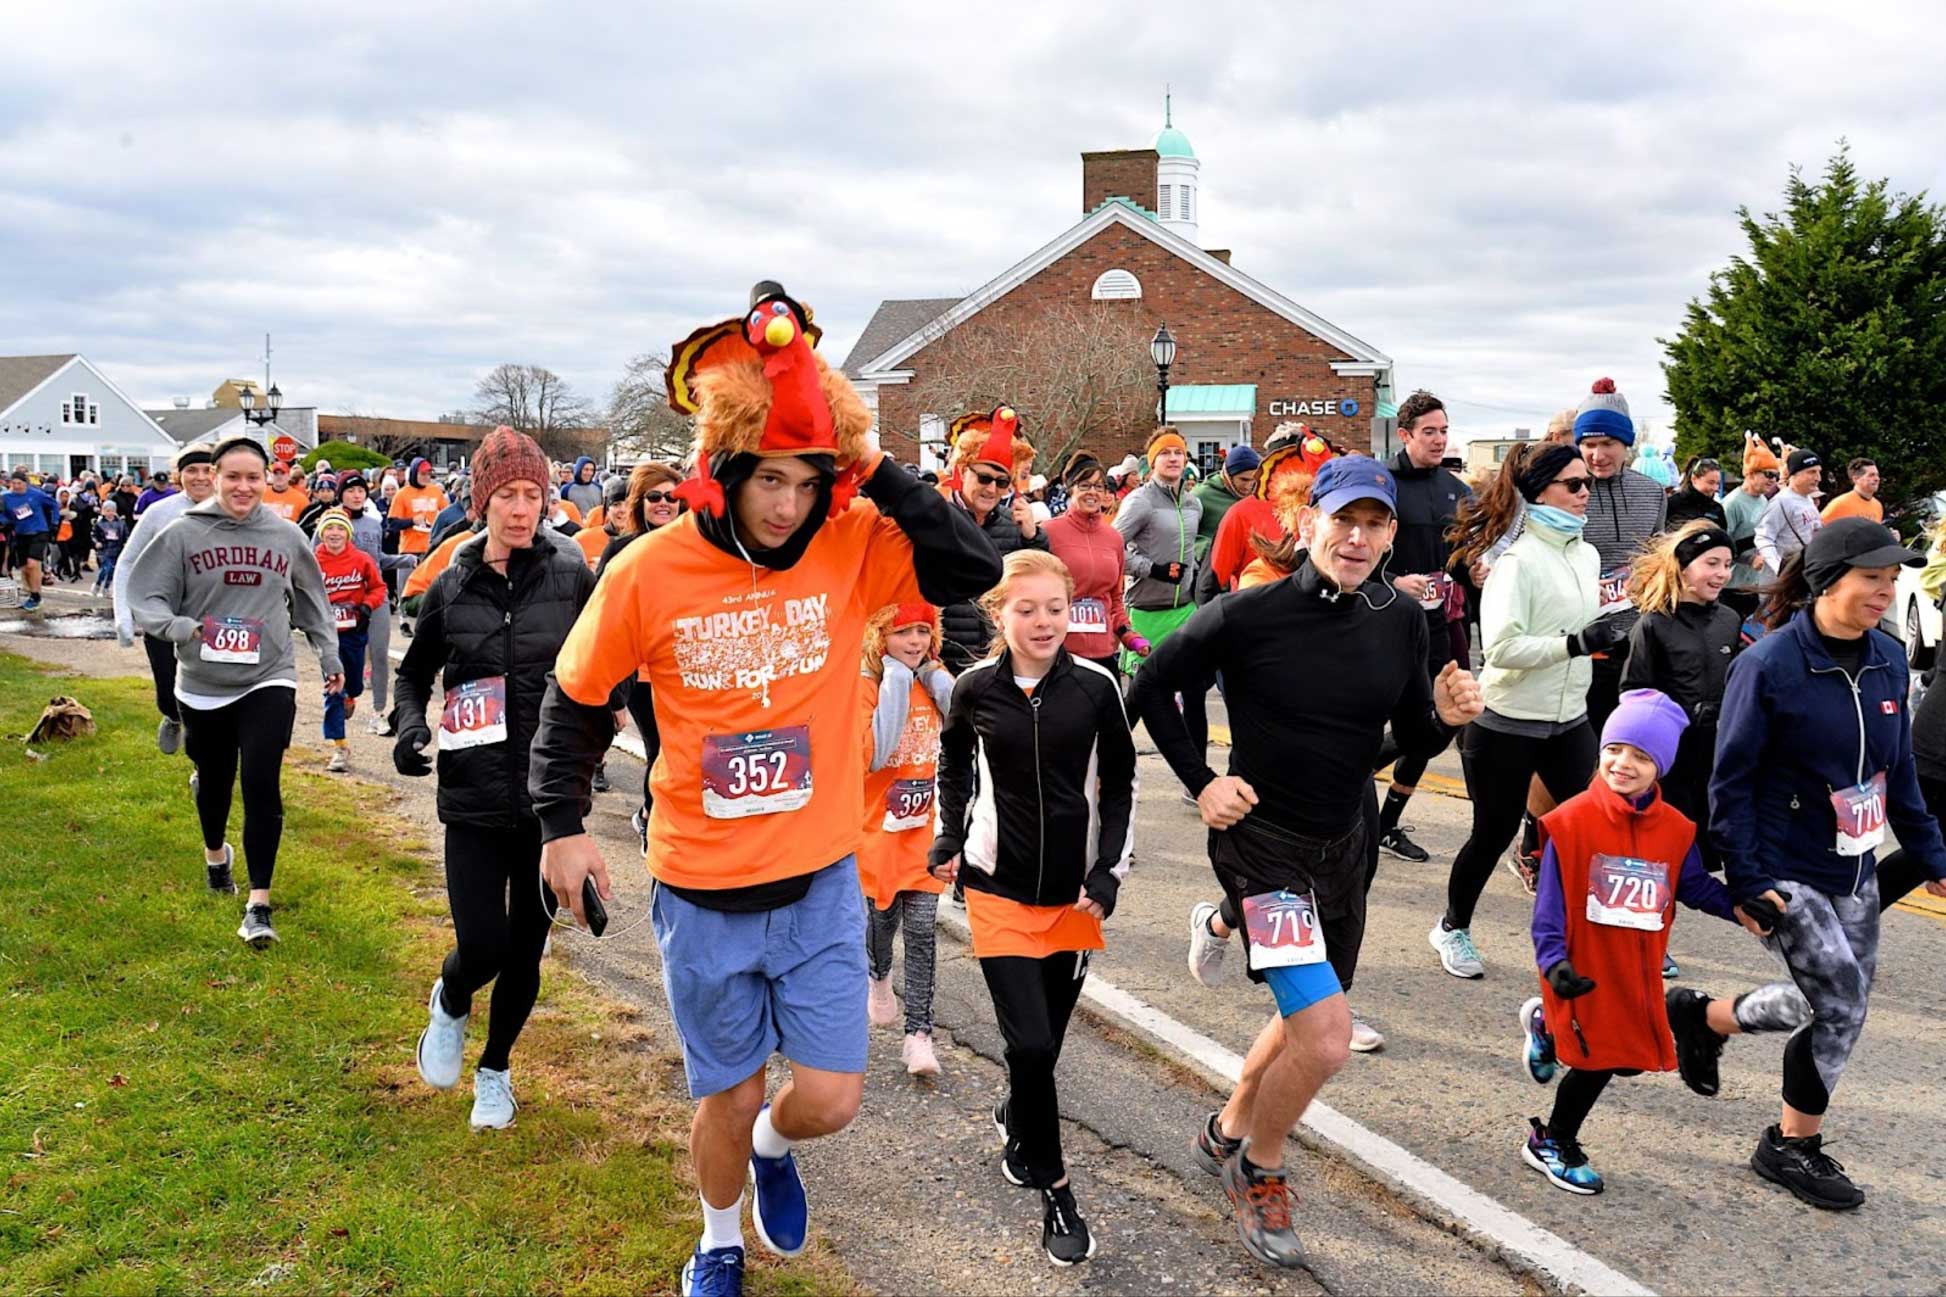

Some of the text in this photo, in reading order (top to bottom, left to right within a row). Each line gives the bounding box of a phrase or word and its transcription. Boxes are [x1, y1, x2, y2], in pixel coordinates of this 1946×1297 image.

[1269, 401, 1337, 416] CHASE
[274, 443, 296, 454] STOP
[190, 546, 289, 577] FORDHAM
[229, 572, 257, 584] LAW
[331, 608, 348, 621] 81
[676, 593, 827, 641] TURKEY DAY
[1071, 606, 1101, 623] 1011
[215, 629, 250, 650] 698
[681, 671, 722, 691] RUN
[735, 664, 777, 690] FOR
[453, 696, 486, 729] 131
[728, 751, 789, 795] 352
[900, 791, 932, 816] 397
[1852, 794, 1883, 835] 770
[1607, 874, 1657, 910] 720
[1267, 910, 1314, 945] 719
